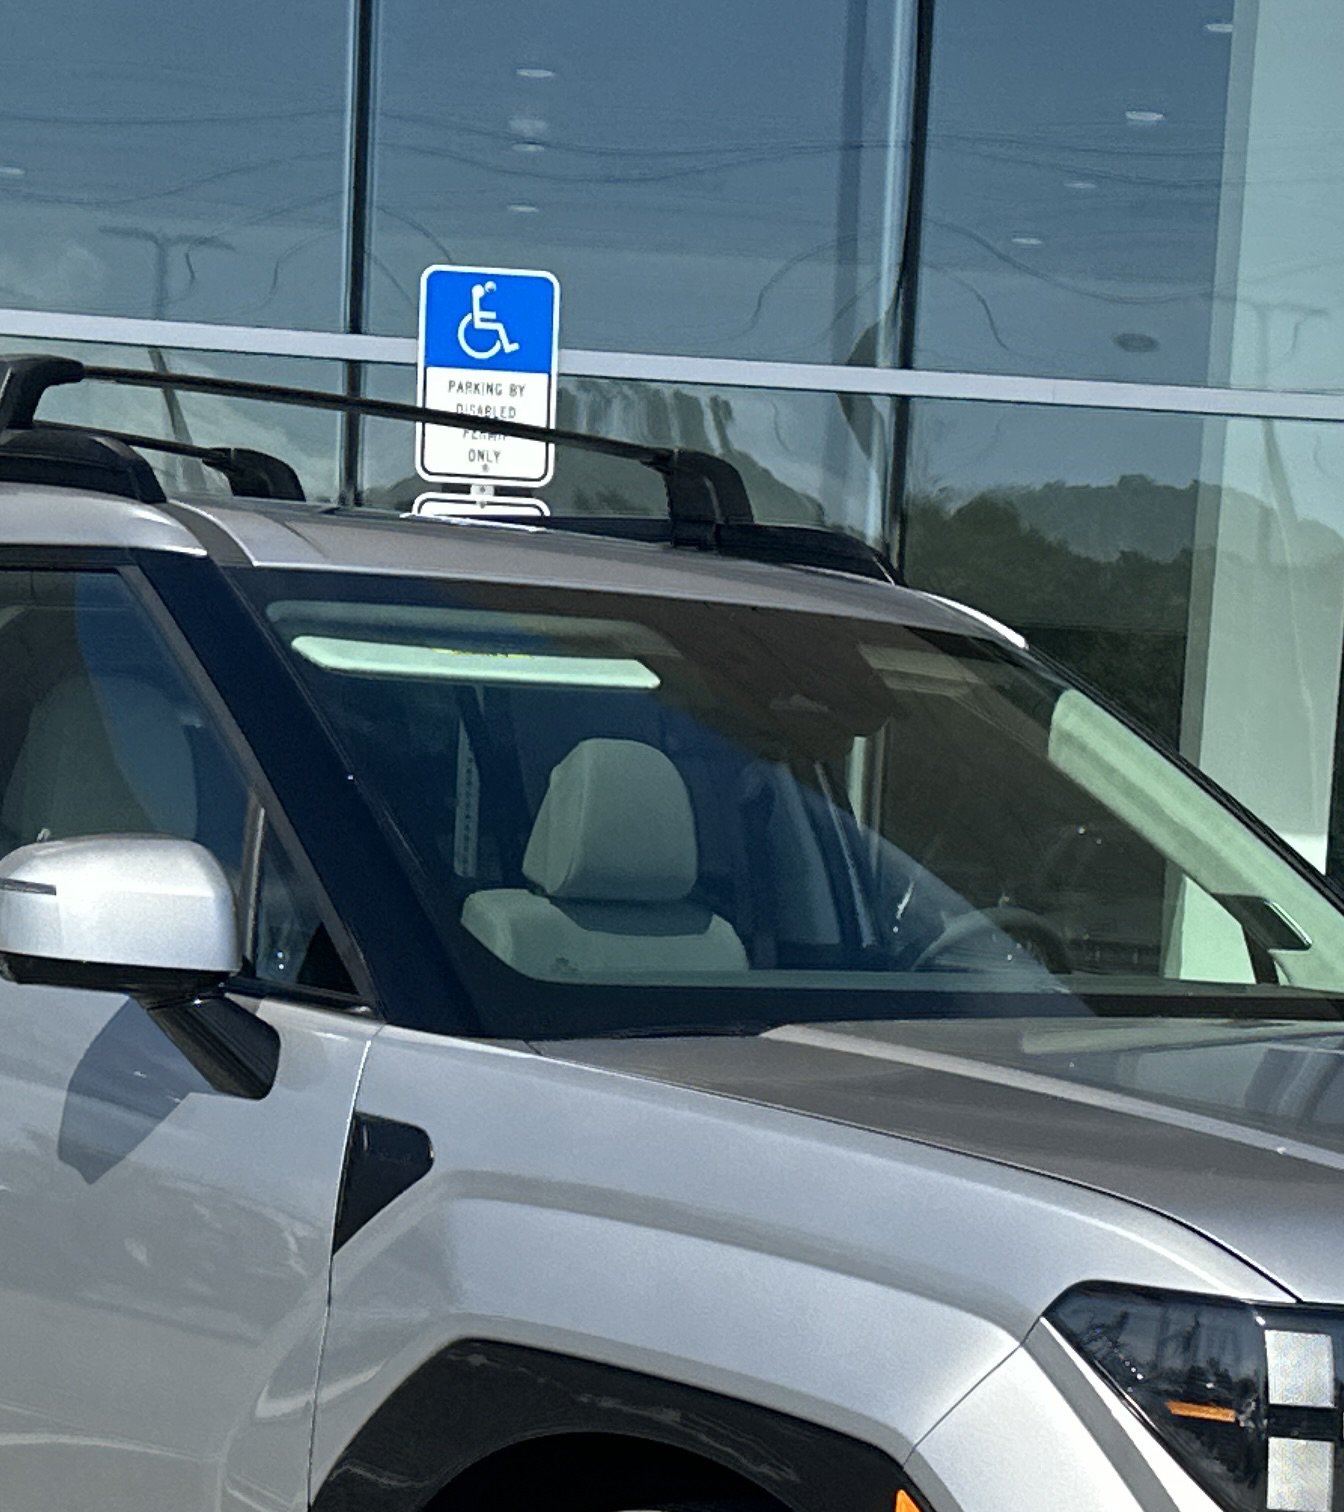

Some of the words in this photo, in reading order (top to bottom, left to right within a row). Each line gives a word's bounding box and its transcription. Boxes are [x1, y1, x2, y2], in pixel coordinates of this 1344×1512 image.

[447, 380, 503, 397] PARKING
[508, 383, 525, 398] BY
[456, 402, 517, 419] DISABLED
[468, 448, 501, 463] ONLY
